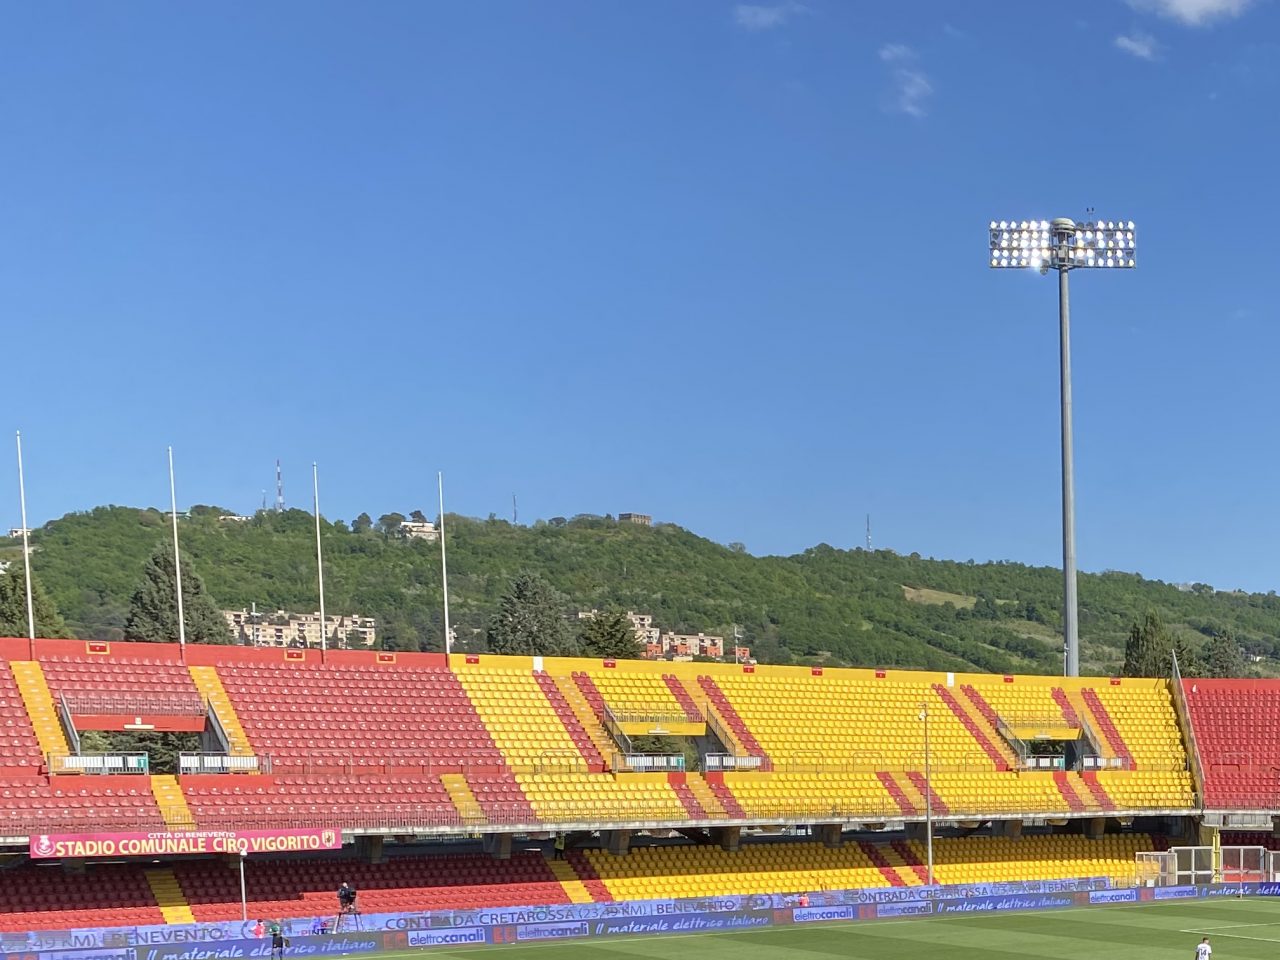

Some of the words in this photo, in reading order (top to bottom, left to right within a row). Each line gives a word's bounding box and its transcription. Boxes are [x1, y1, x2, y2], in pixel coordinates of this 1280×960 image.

[185, 831, 236, 839] BENEVENTO
[56, 840, 115, 857] STADIO
[118, 837, 206, 855] COMUNALE
[213, 837, 249, 853] CIRO
[252, 834, 320, 852] VIGORITO
[479, 908, 575, 925] CRETAROSSA
[656, 899, 736, 914] BENEVENTO
[794, 906, 853, 921] elettrocanali
[946, 900, 994, 912] materiale
[997, 898, 1035, 909] elettrico
[518, 922, 588, 939] elettrocanali
[607, 919, 668, 933] materiale
[673, 916, 722, 930] elettrico
[727, 915, 769, 927] italiano
[410, 928, 484, 947] elettrocanali
[250, 943, 316, 957] elerico
[322, 938, 376, 952] italiano
